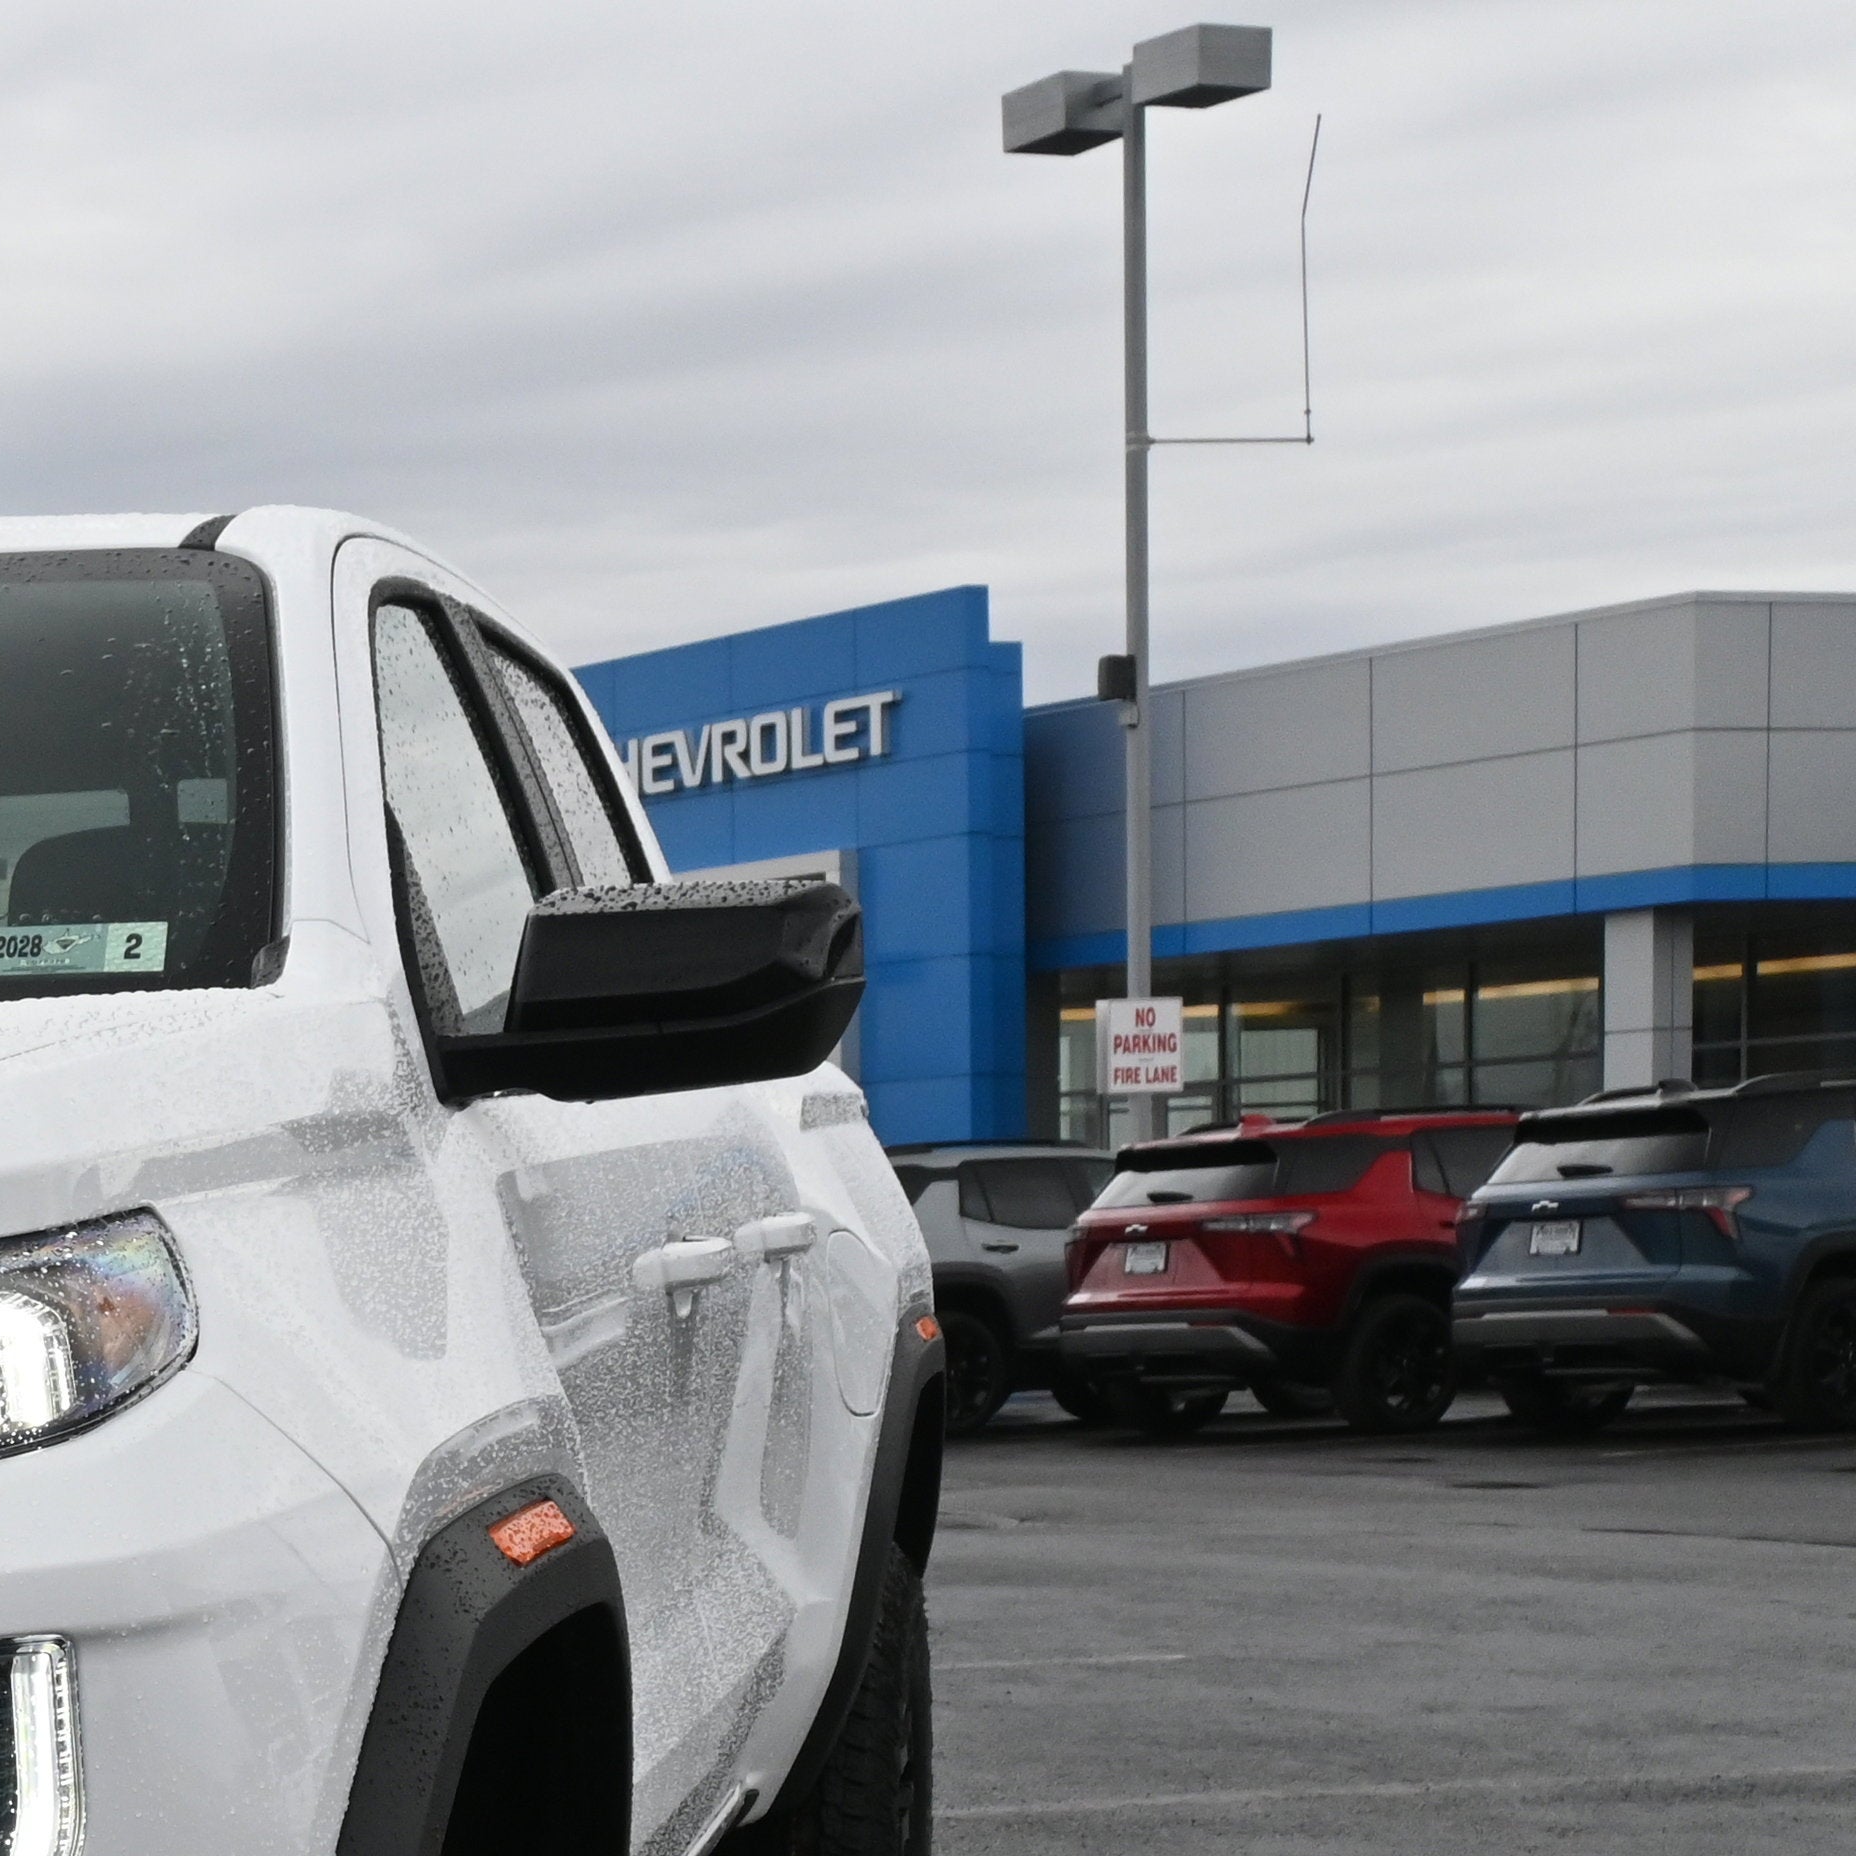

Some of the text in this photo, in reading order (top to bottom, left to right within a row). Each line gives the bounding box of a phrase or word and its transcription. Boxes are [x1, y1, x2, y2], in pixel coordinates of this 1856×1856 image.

[124, 933, 143, 960] 2
[1135, 1008, 1156, 1028] NO
[1114, 1033, 1177, 1054] PARKING
[1114, 1066, 1177, 1085] FIRE LANE
